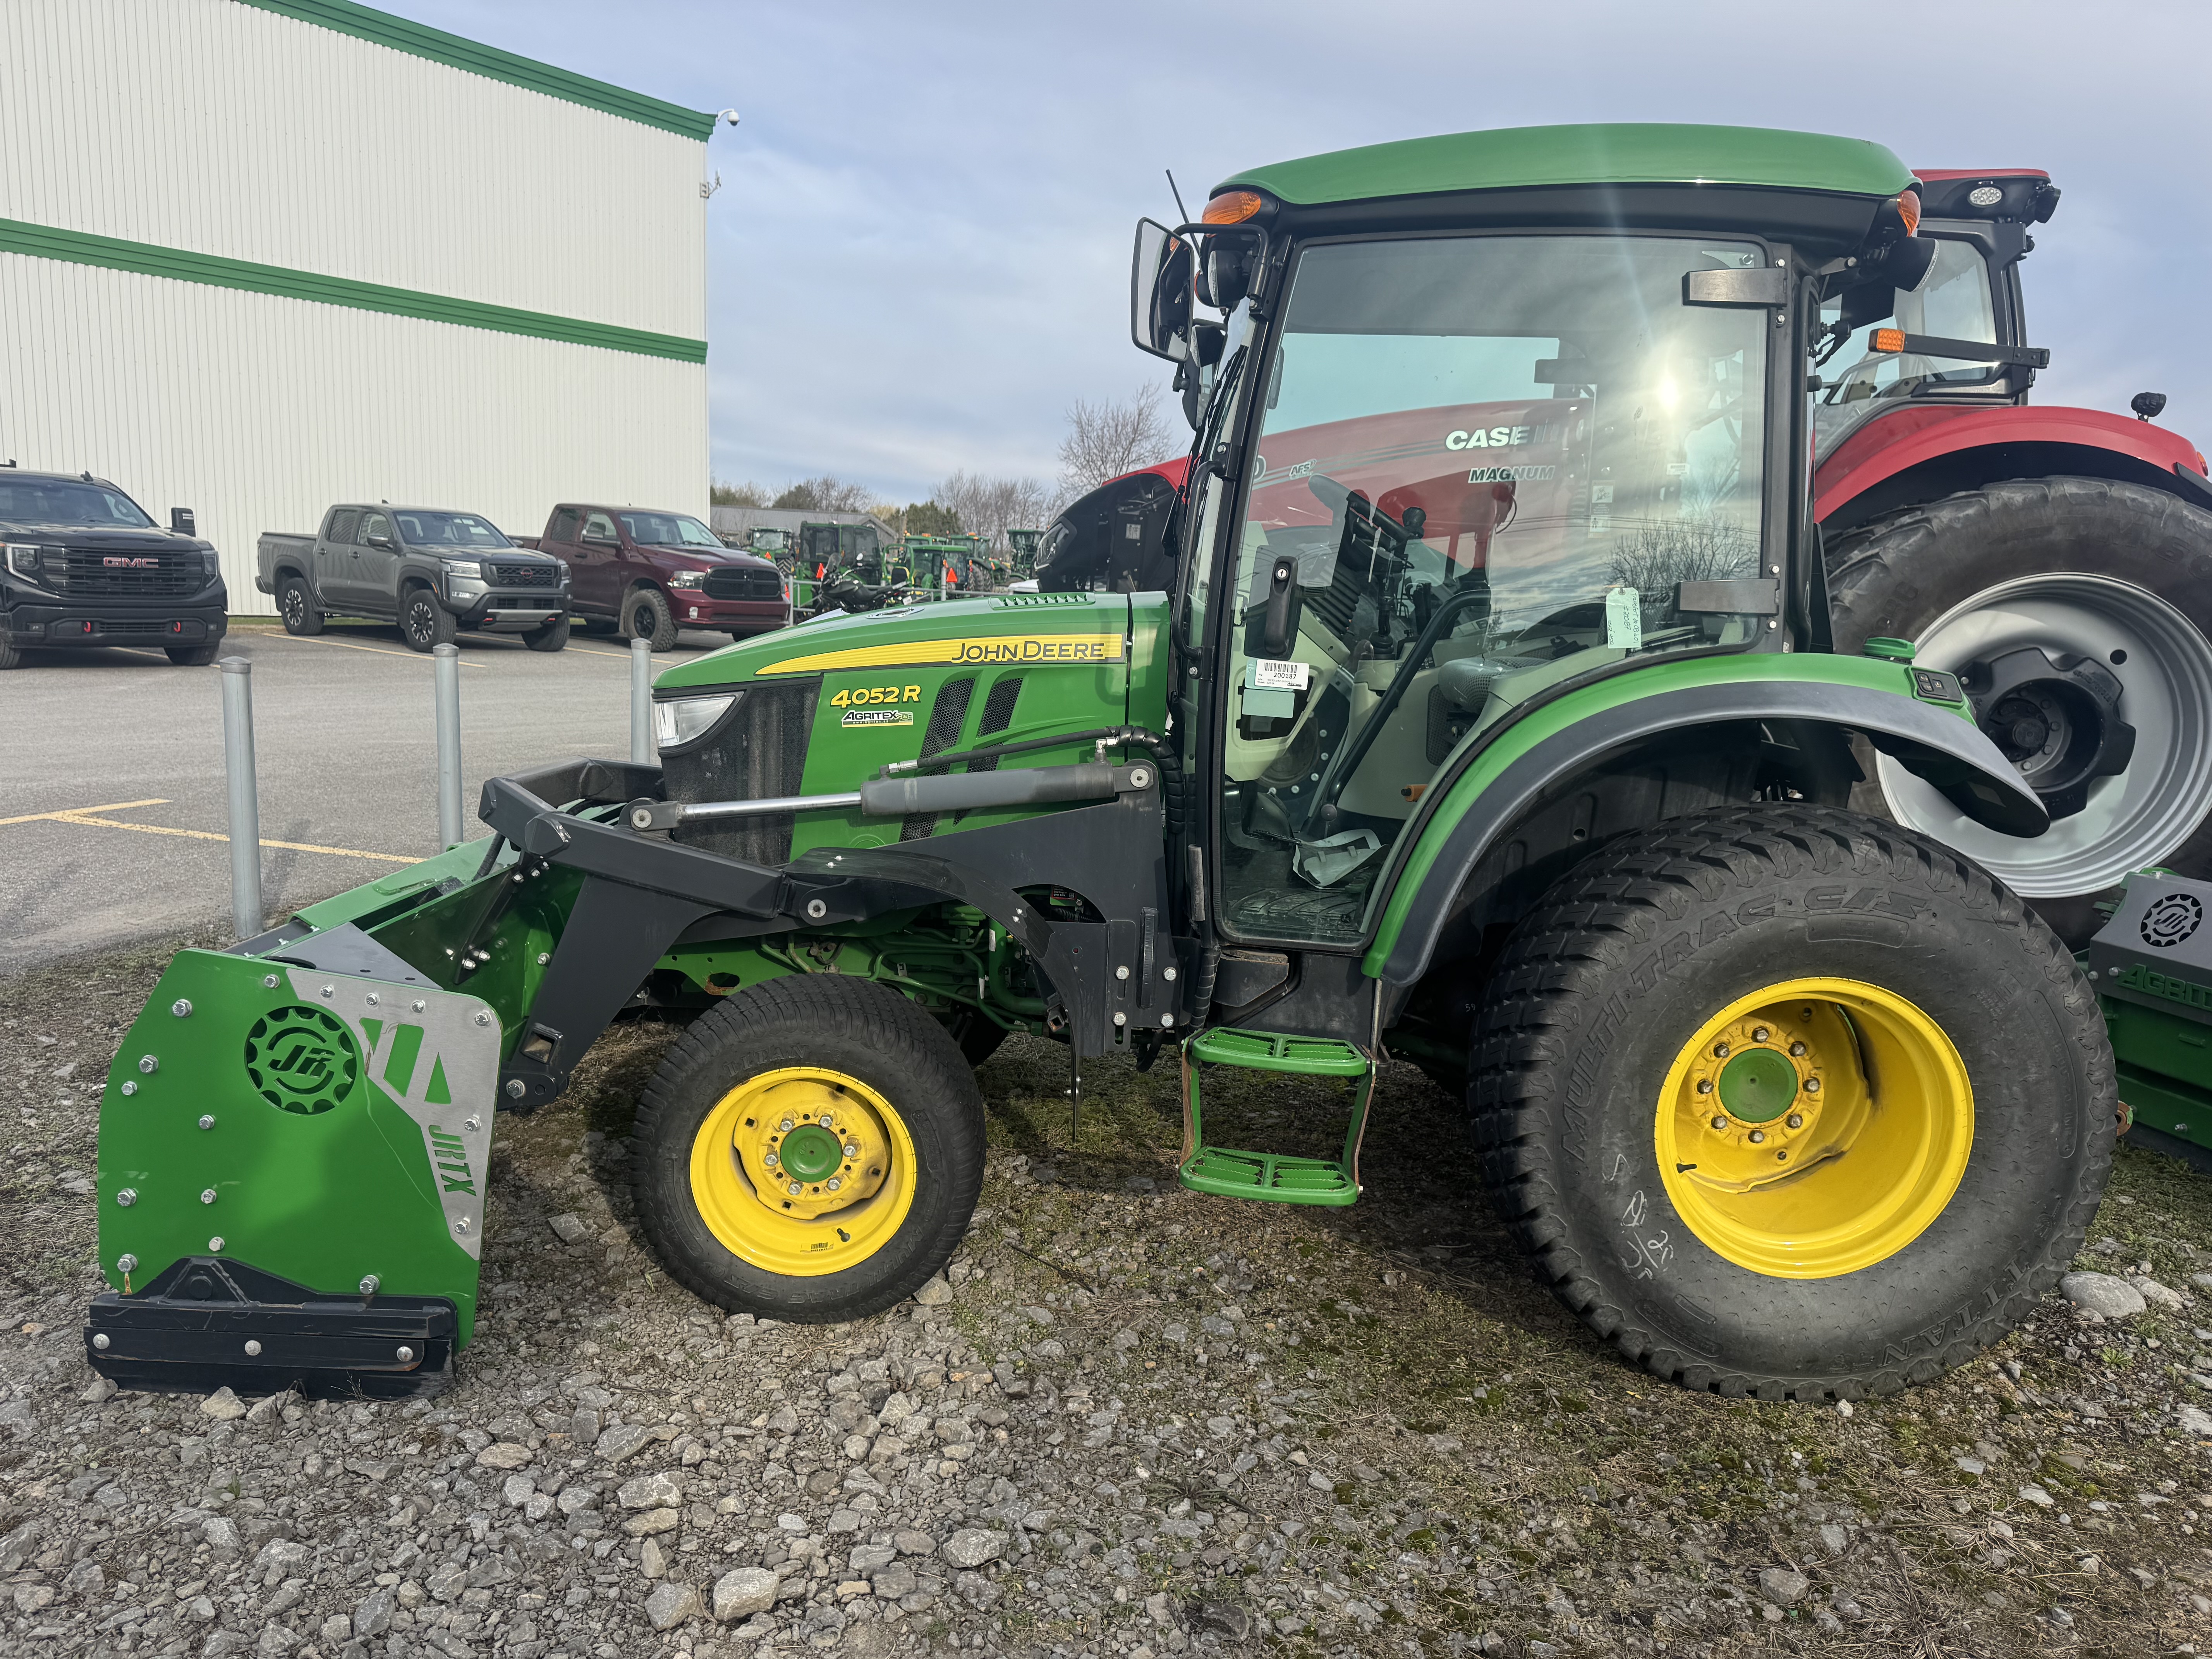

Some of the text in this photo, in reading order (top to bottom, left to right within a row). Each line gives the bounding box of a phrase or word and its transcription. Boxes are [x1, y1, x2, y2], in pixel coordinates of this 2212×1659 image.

[1446, 426, 1530, 450] CASE
[1290, 462, 1311, 475] AFS
[1468, 465, 1555, 484] MAGNUM
[103, 557, 159, 568] GMC
[951, 641, 1105, 661] JOHN DEERE
[843, 711, 898, 721] AGRITEX
[1561, 991, 1629, 1161] MULTI
[1631, 893, 1776, 993] TRAC
[723, 1044, 809, 1078] TITAN
[866, 1226, 924, 1286] MULTI
[788, 1285, 862, 1304] TRAC
[1877, 1255, 2030, 1368] TITAN
